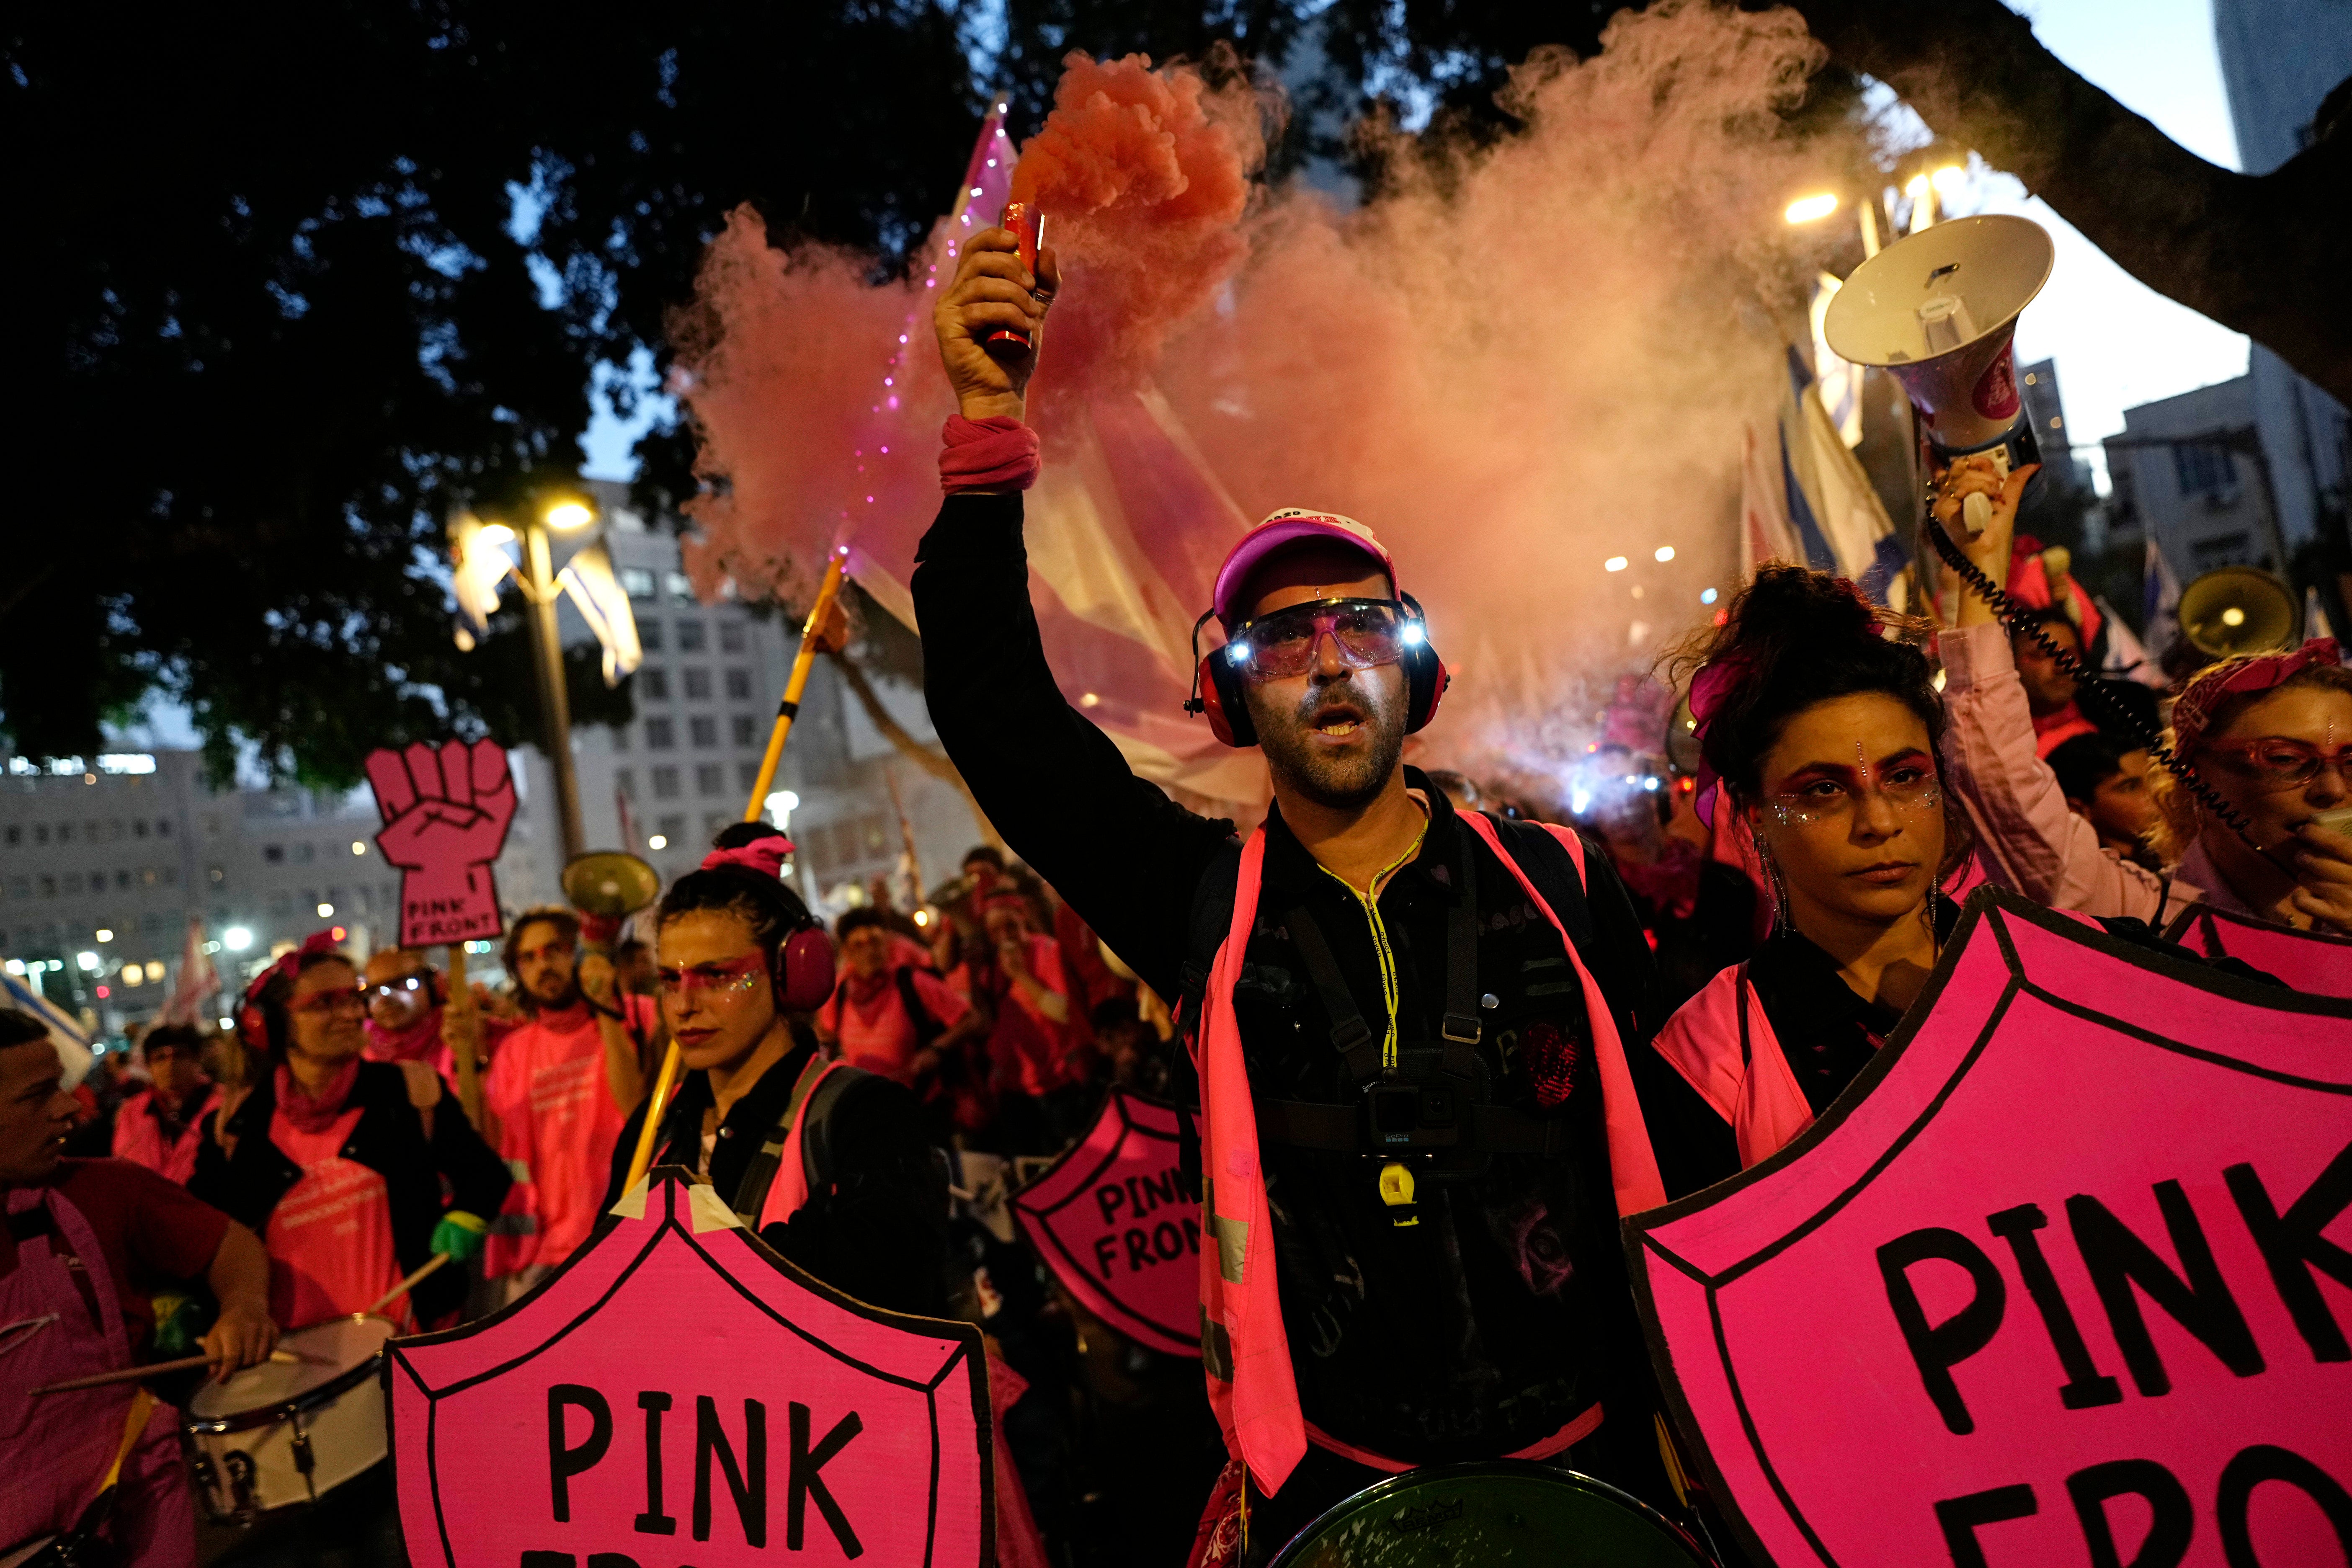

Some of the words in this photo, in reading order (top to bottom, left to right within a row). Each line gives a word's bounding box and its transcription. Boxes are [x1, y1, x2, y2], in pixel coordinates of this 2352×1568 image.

[407, 897, 466, 918] PINK
[410, 912, 490, 940] FRONT
[1372, 935, 1382, 957] FOX40
[1381, 931, 1391, 954] FOX40
[1362, 1080, 1382, 1089] GoPro
[1875, 1144, 2352, 1434] PINK
[548, 1384, 864, 1560] PINK
[1403, 1509, 1456, 1529] REMO
